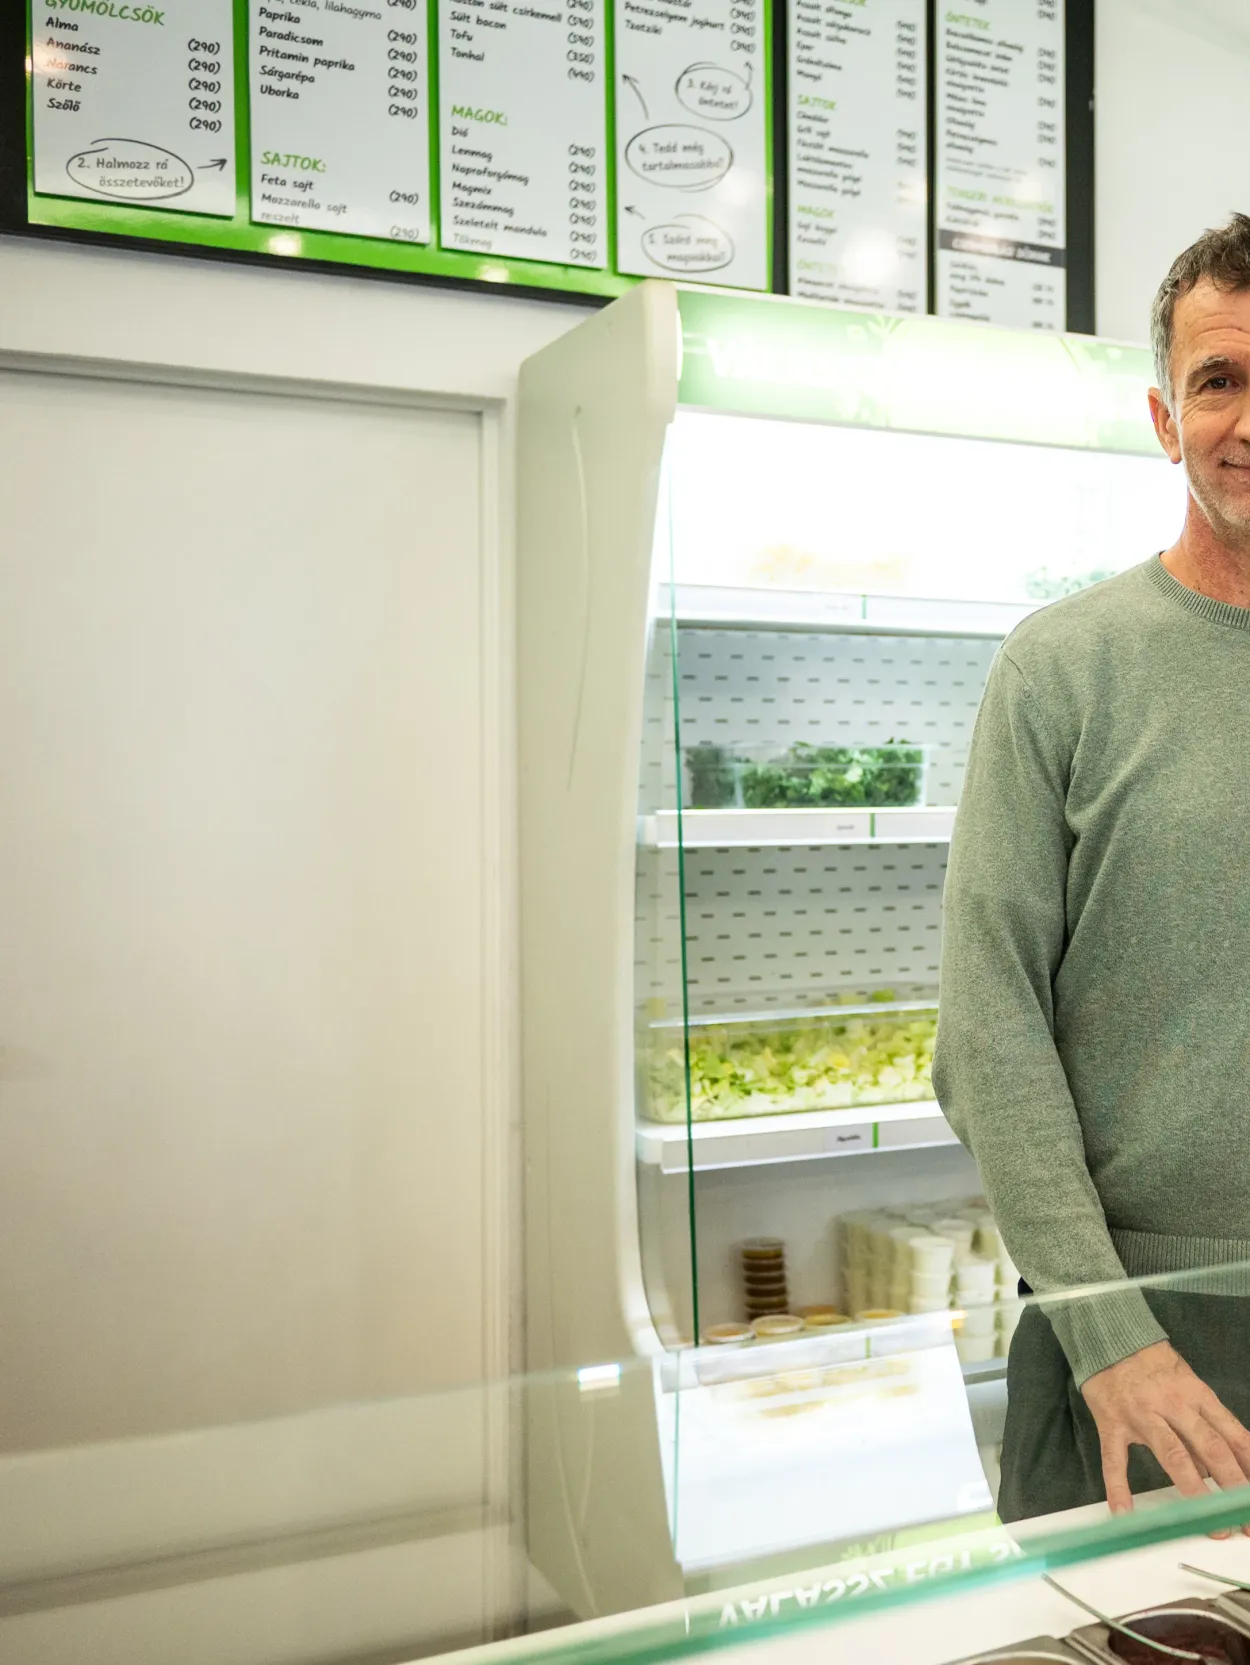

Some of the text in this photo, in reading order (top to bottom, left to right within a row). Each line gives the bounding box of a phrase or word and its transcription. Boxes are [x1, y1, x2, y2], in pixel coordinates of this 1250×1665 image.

[324, 0, 382, 21] lilahagyma
[450, 10, 471, 23] Sült
[475, 15, 507, 29] bacon
[45, 16, 221, 55] Alma (290)
[258, 7, 417, 45] Paprika (290)
[450, 28, 474, 42] Tofu
[46, 37, 221, 75] Ananász (290)
[259, 26, 418, 64] Paradicsom (290)
[451, 47, 485, 62] Tonhal
[259, 45, 418, 82] Pritamin paprika (290)
[47, 58, 222, 94] Narancs (290)
[259, 65, 418, 101] Sárgarépa (290)
[46, 77, 222, 114] Körte (290)
[260, 84, 418, 119] Uborka (290)
[46, 98, 222, 133] Szőlő (290)
[451, 125, 470, 138] Dió
[77, 156, 169, 169] 2. Halmozz rá
[260, 150, 327, 173] SAJTOK:
[451, 145, 493, 162] Lenmag
[99, 175, 184, 188] összetevőket!
[452, 163, 530, 186] Napraforgómag
[260, 173, 419, 206] Feta sajt (290)
[261, 193, 348, 216] Mozzarella sajt
[452, 197, 515, 218] Szezámmag
[261, 212, 420, 241] reszelt (290)
[453, 215, 499, 231] Szeletelt
[503, 223, 548, 238] mandula
